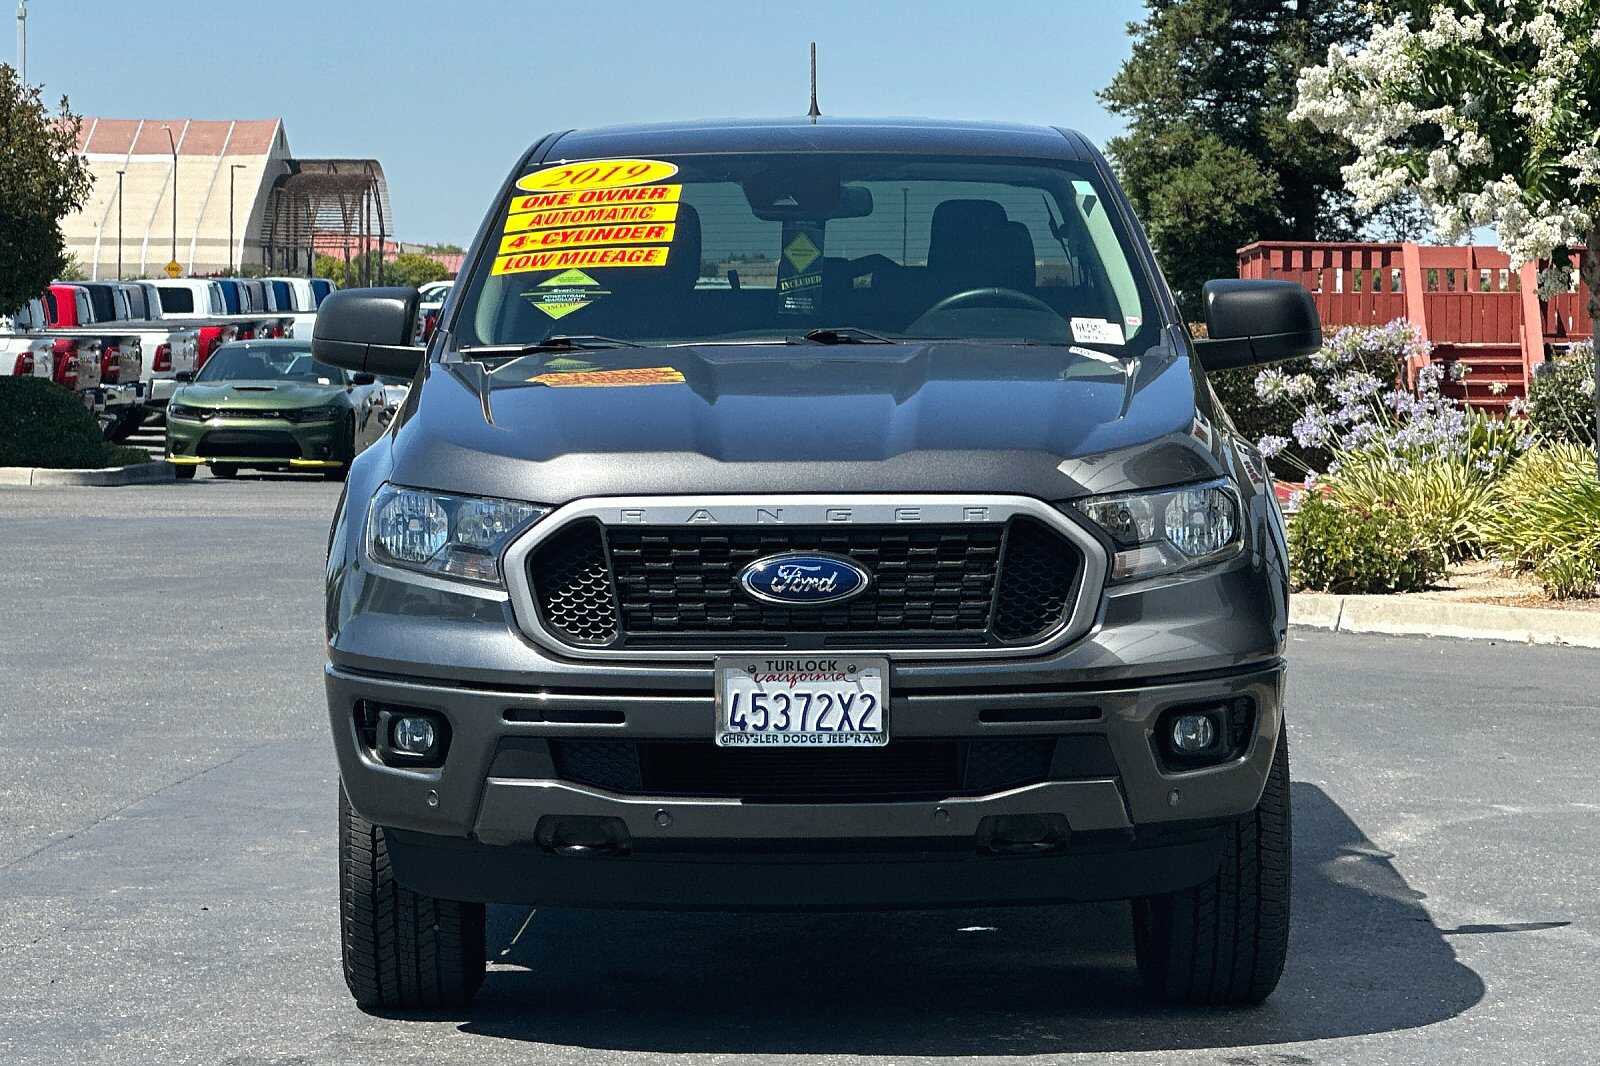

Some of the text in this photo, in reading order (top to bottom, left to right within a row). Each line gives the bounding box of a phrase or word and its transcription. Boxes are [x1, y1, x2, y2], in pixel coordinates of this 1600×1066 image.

[543, 164, 651, 187] 2019
[521, 188, 669, 209] ONE OWNER
[528, 207, 656, 226] AUTOMATIC
[509, 226, 668, 248] 4-CYLINDER
[503, 250, 659, 270] LOW MILEAGE
[620, 508, 990, 523] RANGER
[771, 565, 837, 593] Ford
[766, 660, 837, 672] TURLOCK
[729, 693, 877, 731] 45372X2
[721, 733, 779, 744] CHRYSLER
[783, 733, 823, 744] DODGE
[854, 733, 882, 744] RAM
